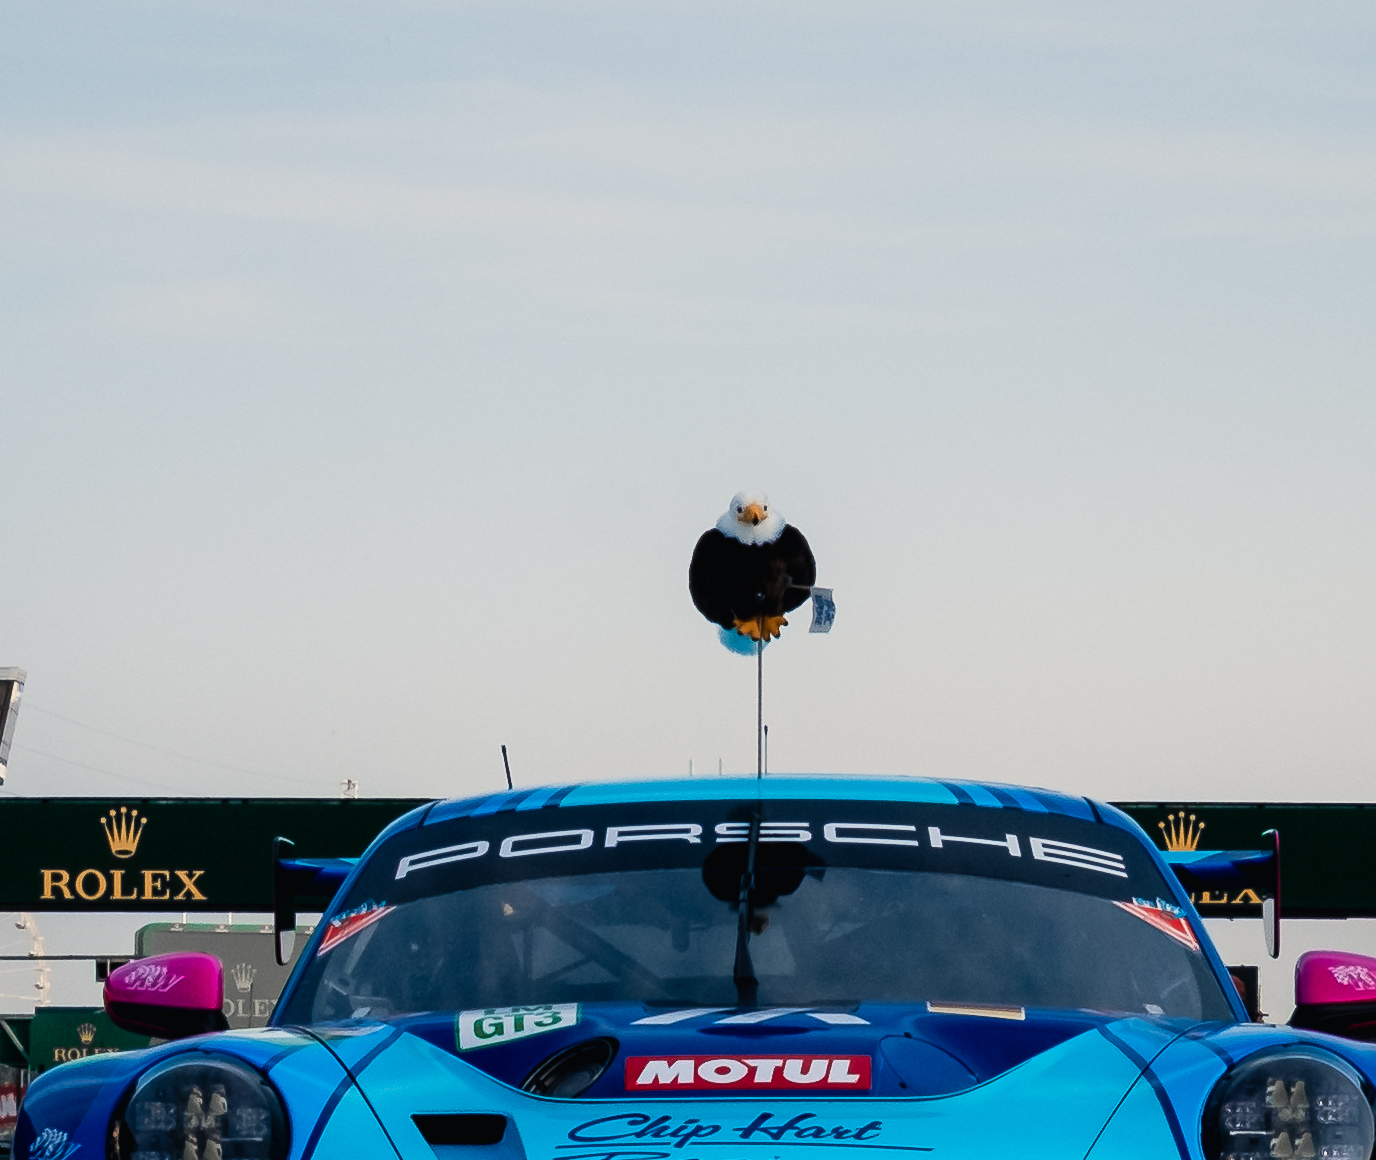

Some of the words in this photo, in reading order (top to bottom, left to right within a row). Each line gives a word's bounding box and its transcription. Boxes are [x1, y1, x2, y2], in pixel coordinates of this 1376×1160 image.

[396, 821, 1128, 879] PORSCHE
[40, 868, 208, 901] ROLEX
[225, 999, 277, 1018] OLE
[473, 1012, 563, 1040] GT3
[635, 1059, 860, 1084] MOTUL
[567, 1113, 722, 1148] Chip
[732, 1113, 883, 1142] Hart
